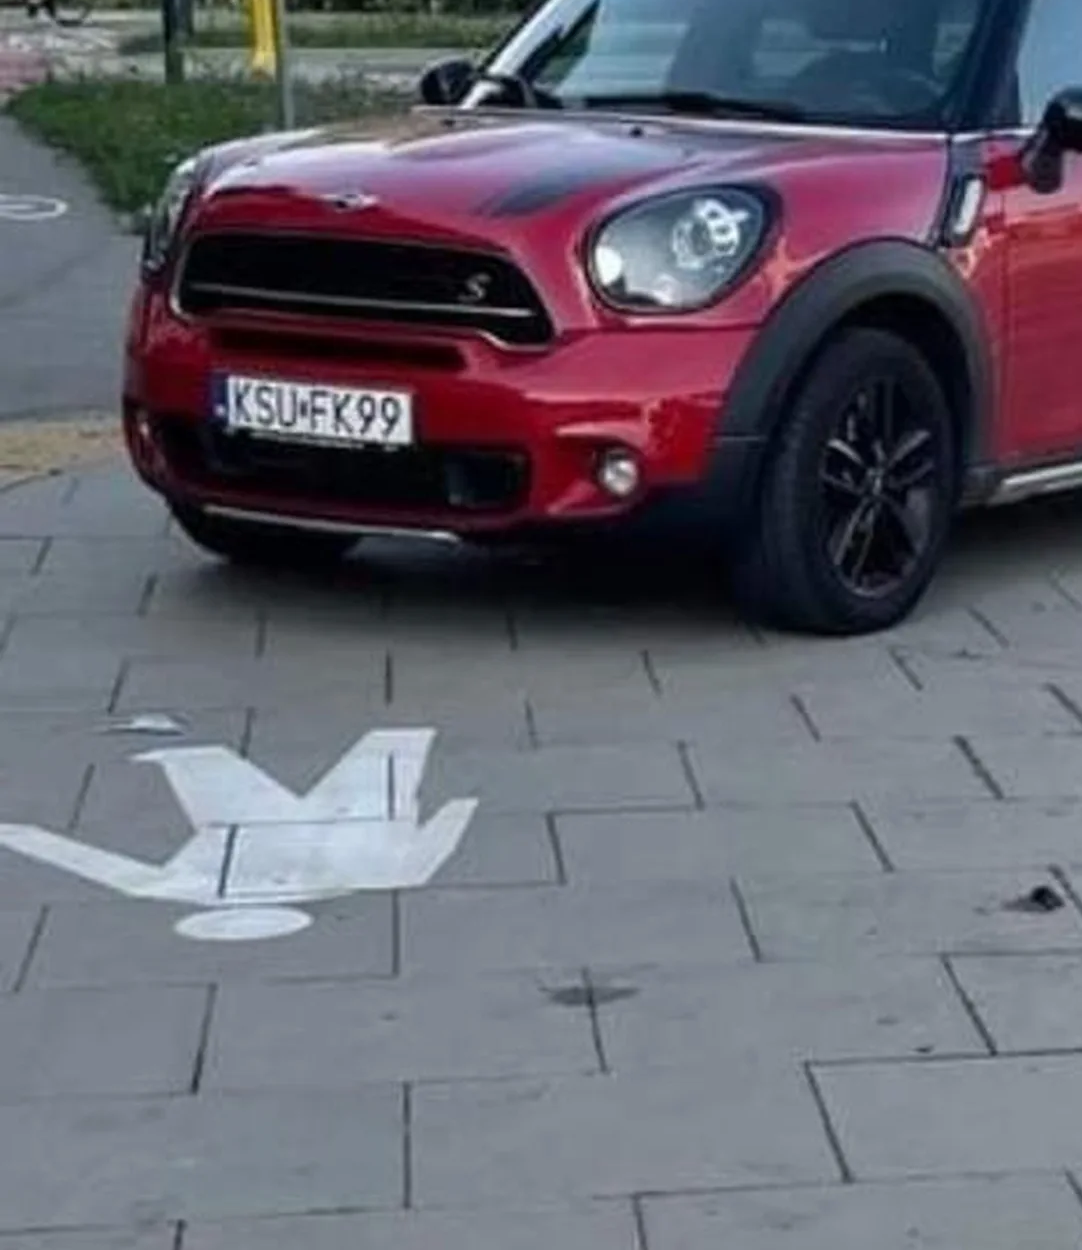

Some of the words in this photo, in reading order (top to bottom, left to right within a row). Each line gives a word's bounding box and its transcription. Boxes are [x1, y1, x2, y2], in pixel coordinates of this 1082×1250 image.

[459, 272, 491, 303] S
[234, 381, 298, 427] KSU
[310, 390, 400, 437] FK99
